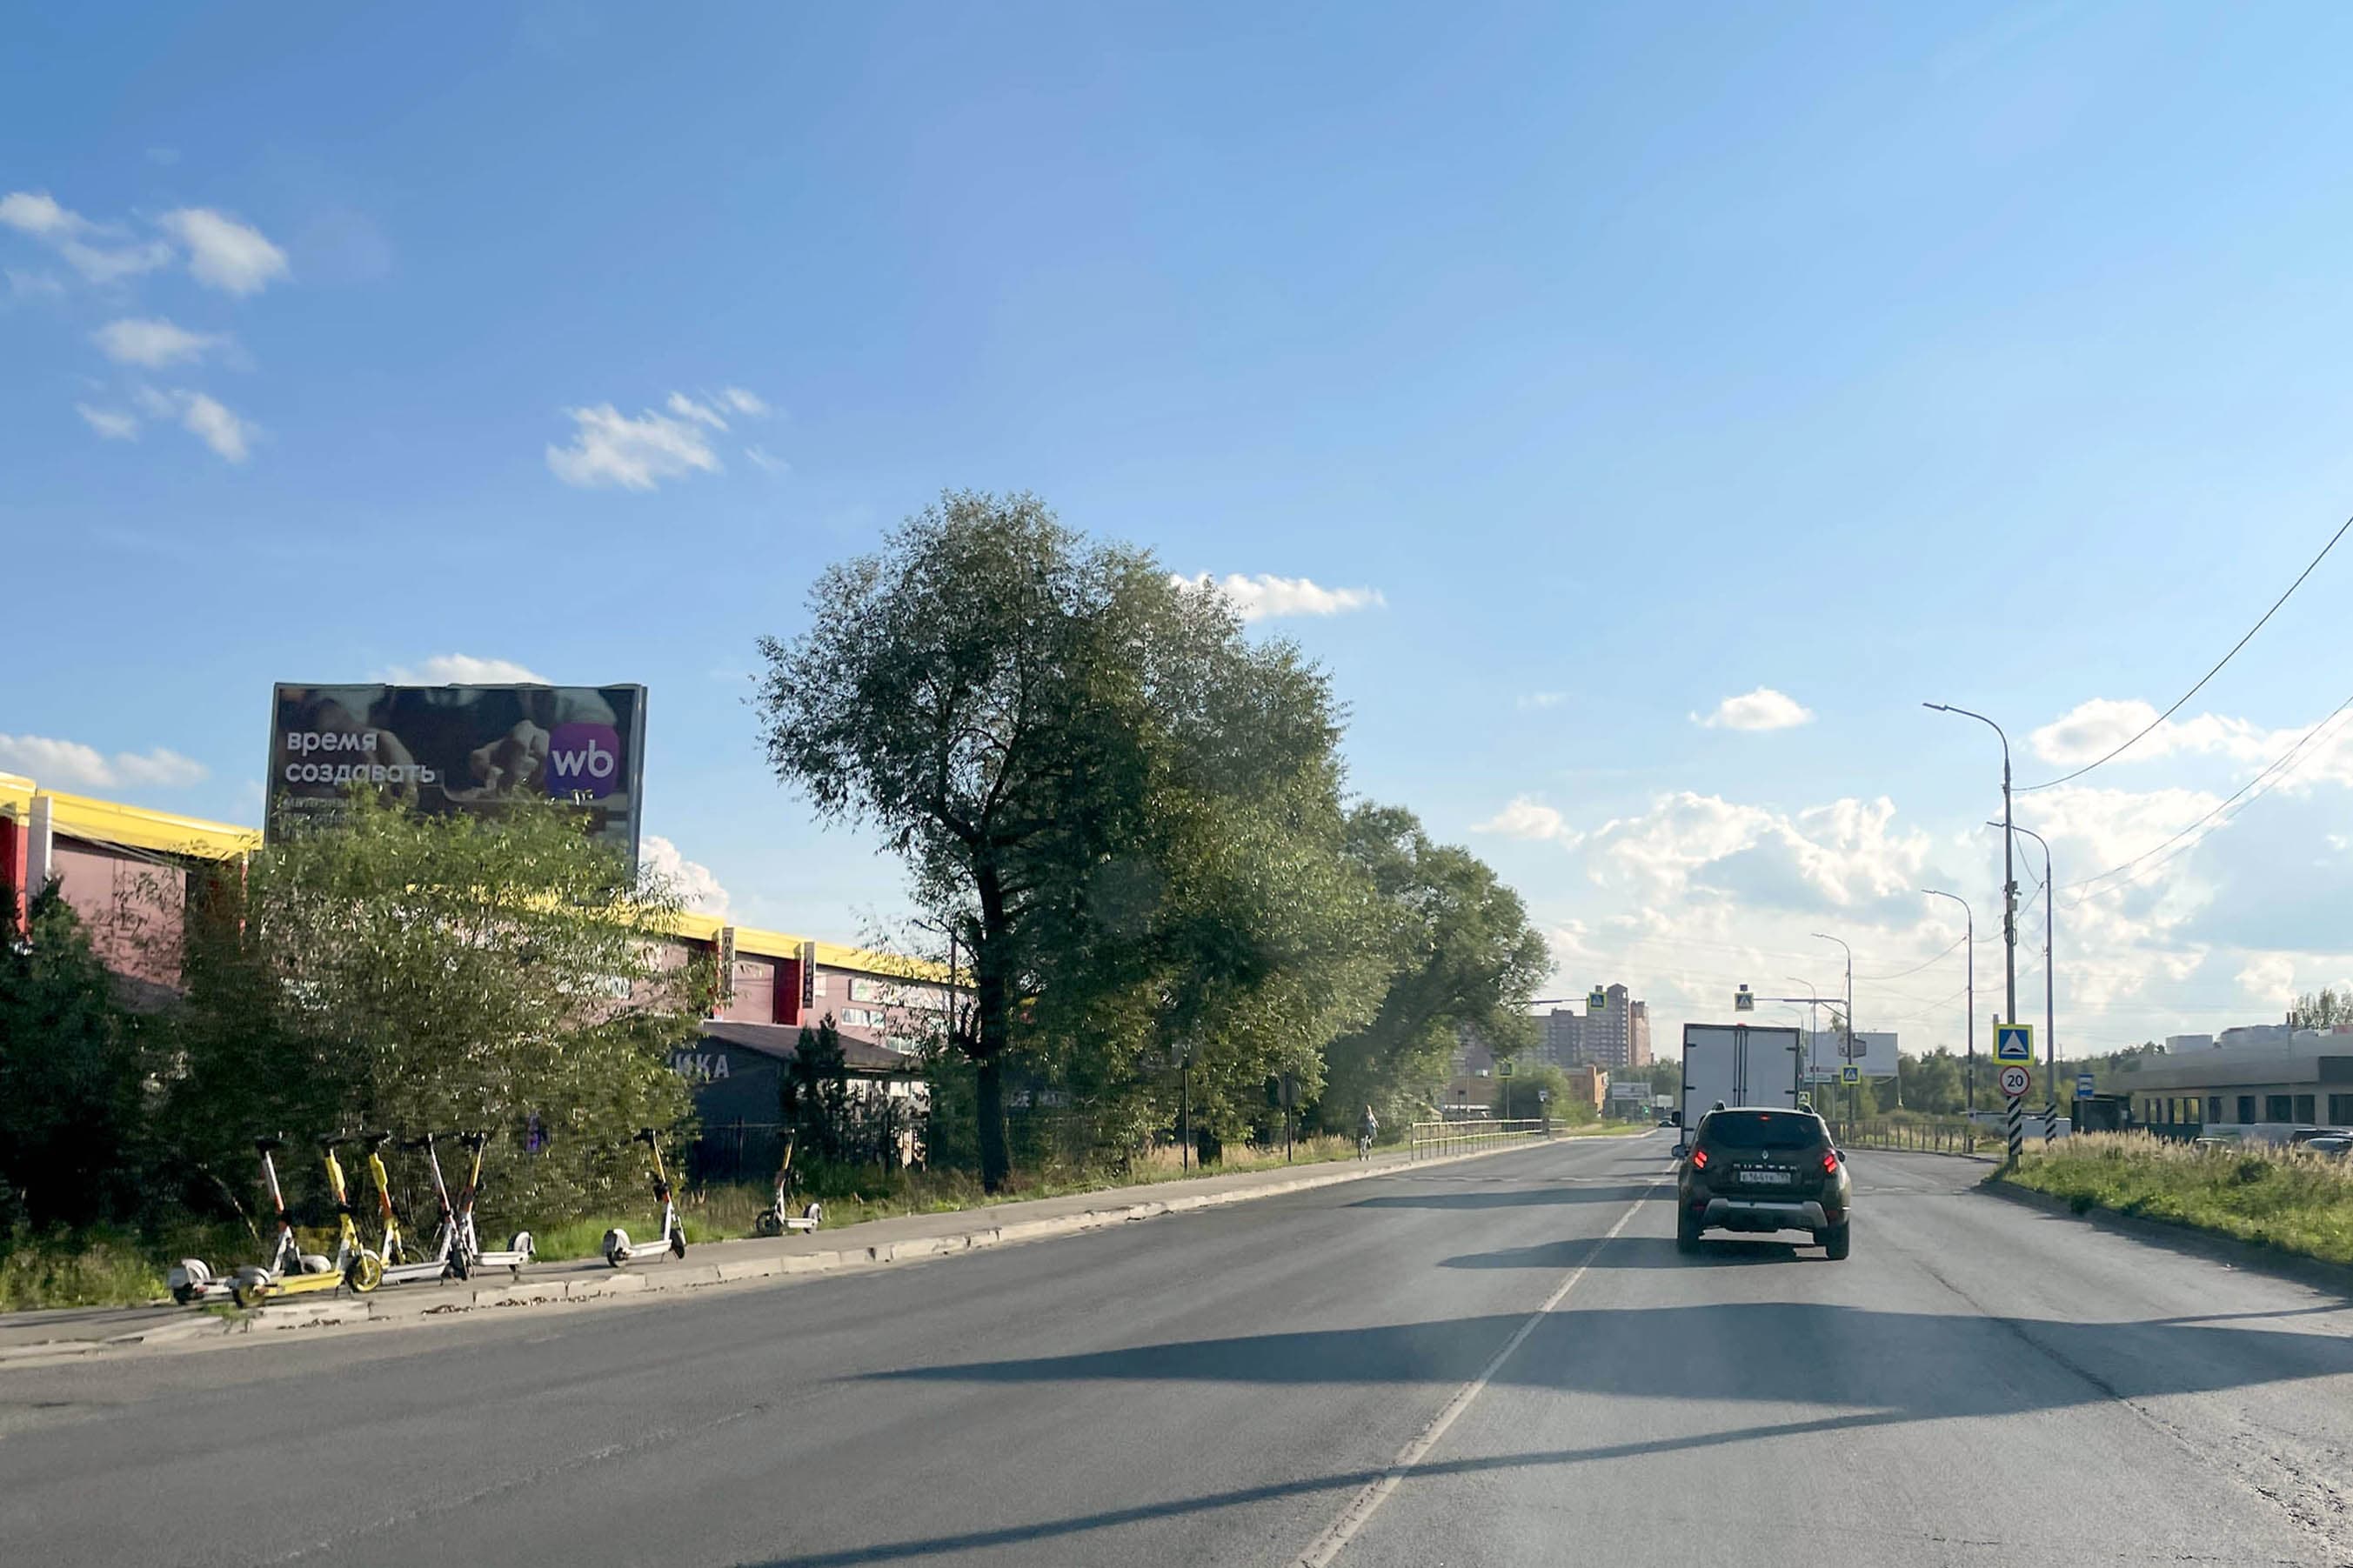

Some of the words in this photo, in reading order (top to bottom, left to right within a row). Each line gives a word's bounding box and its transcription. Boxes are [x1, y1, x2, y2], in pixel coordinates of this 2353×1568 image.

[286, 731, 378, 757] время
[551, 739, 614, 777] wb
[284, 761, 436, 784] создавать
[2008, 1074, 2023, 1087] 20
